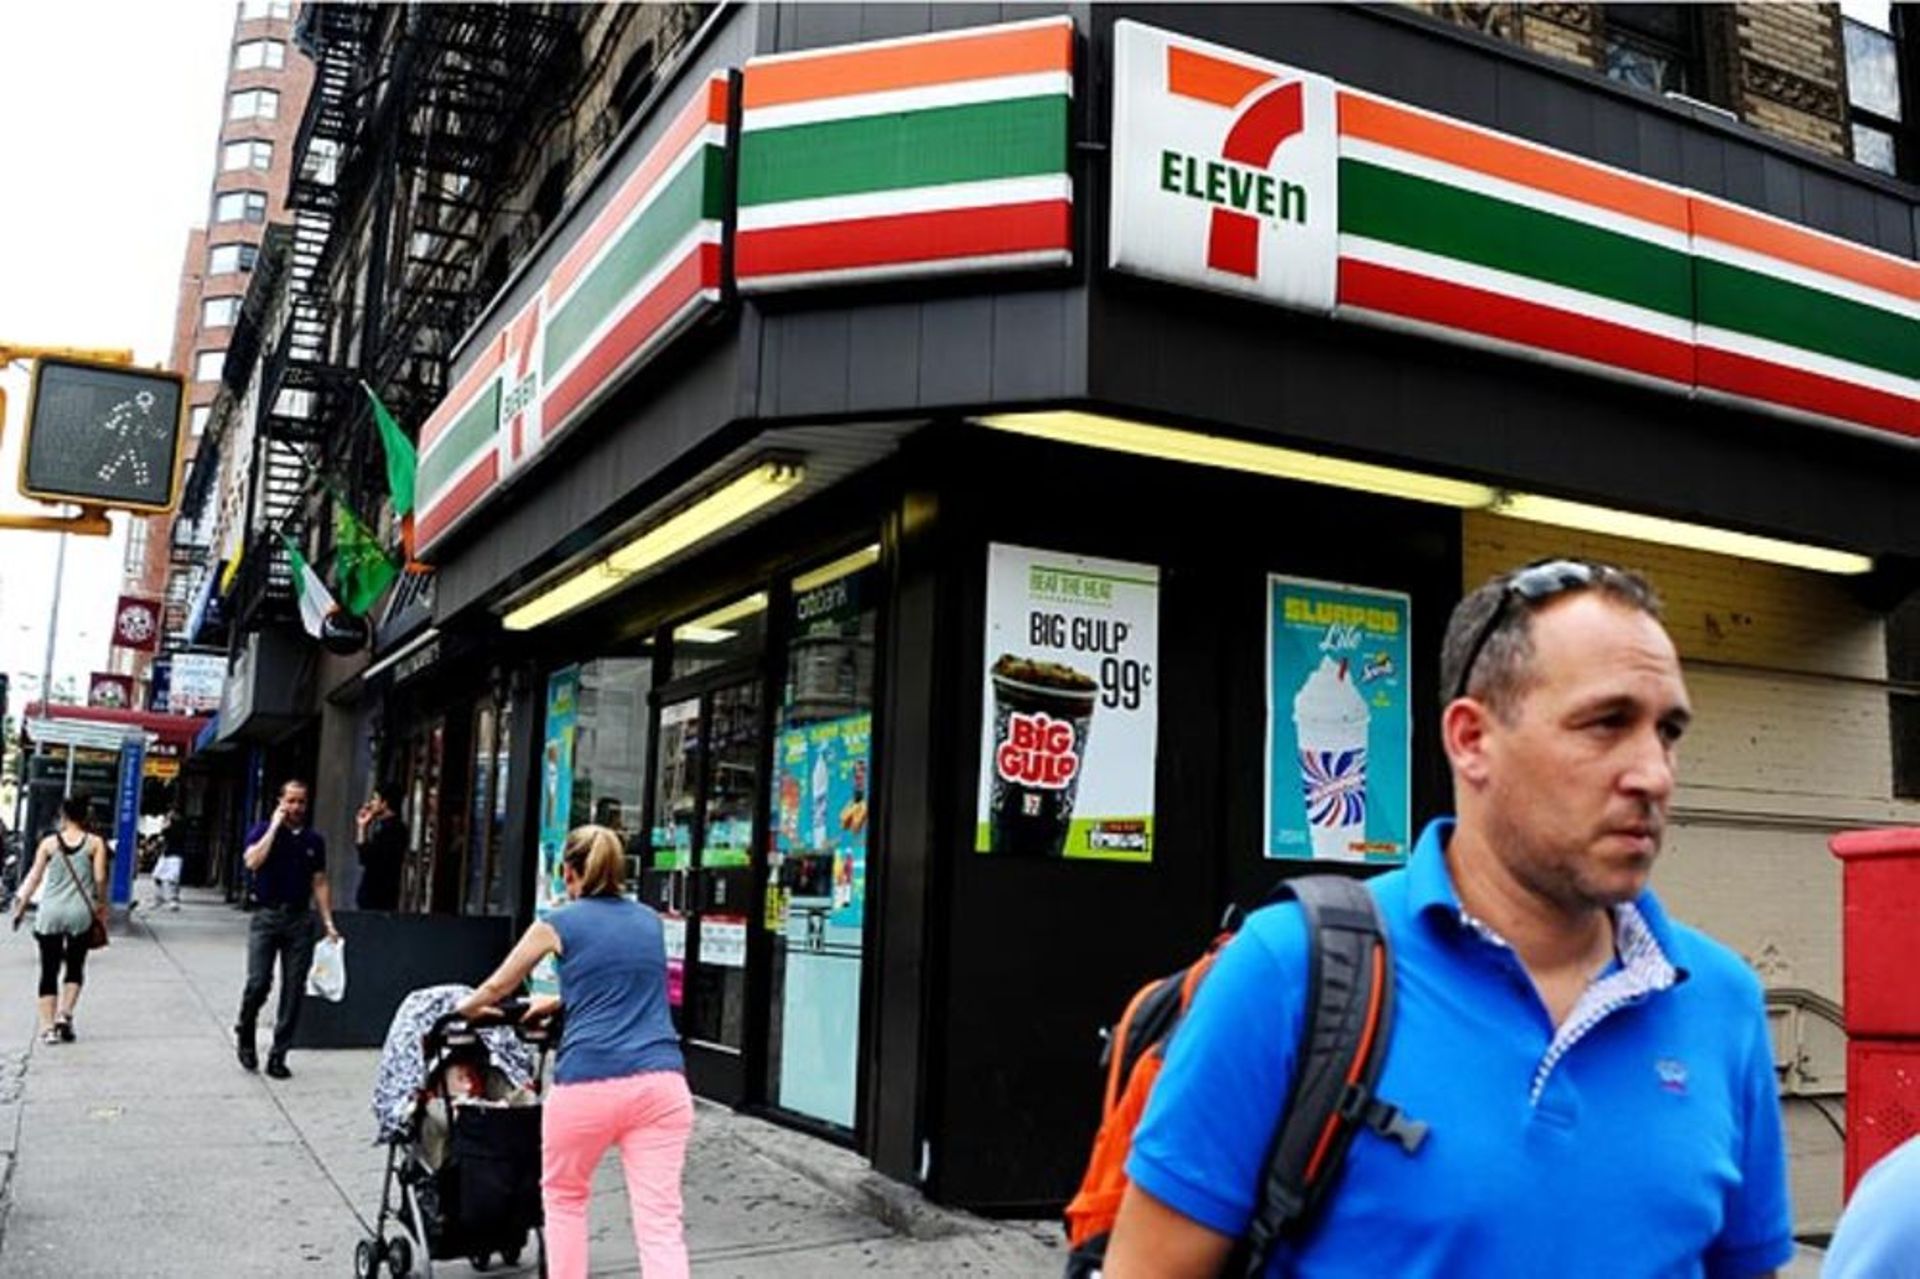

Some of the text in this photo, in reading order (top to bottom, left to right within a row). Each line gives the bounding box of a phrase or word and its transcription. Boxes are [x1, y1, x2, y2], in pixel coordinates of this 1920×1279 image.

[1167, 45, 1304, 279] 7
[1030, 611, 1128, 654] BIG GULP
[999, 745, 1076, 784] GULP
